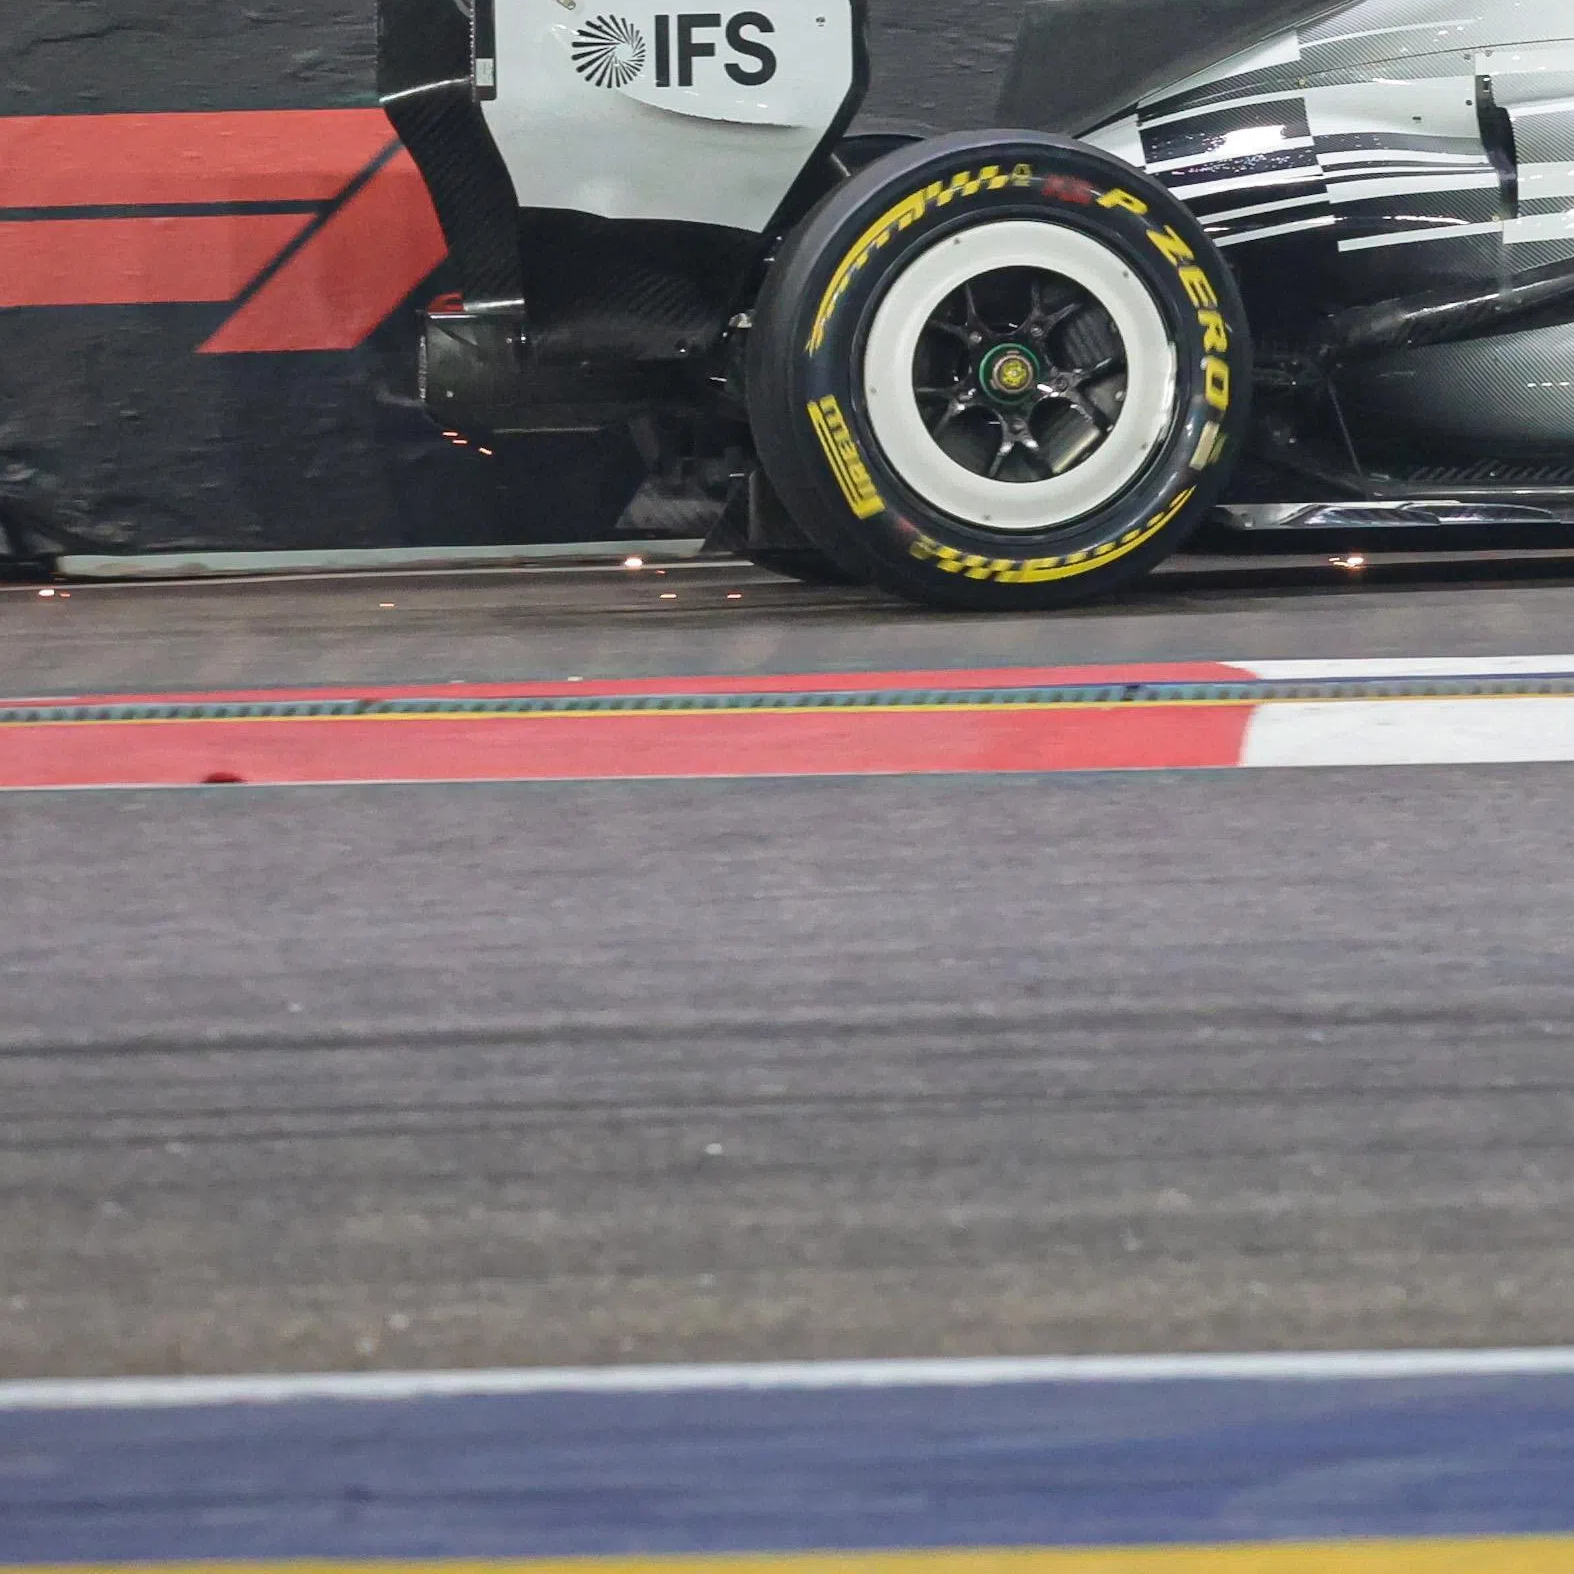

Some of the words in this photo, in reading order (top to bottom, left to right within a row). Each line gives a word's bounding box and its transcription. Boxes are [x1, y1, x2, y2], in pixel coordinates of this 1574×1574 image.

[655, 11, 777, 87] IFS
[1096, 188, 1148, 215] P
[1146, 225, 1230, 410] ZERO
